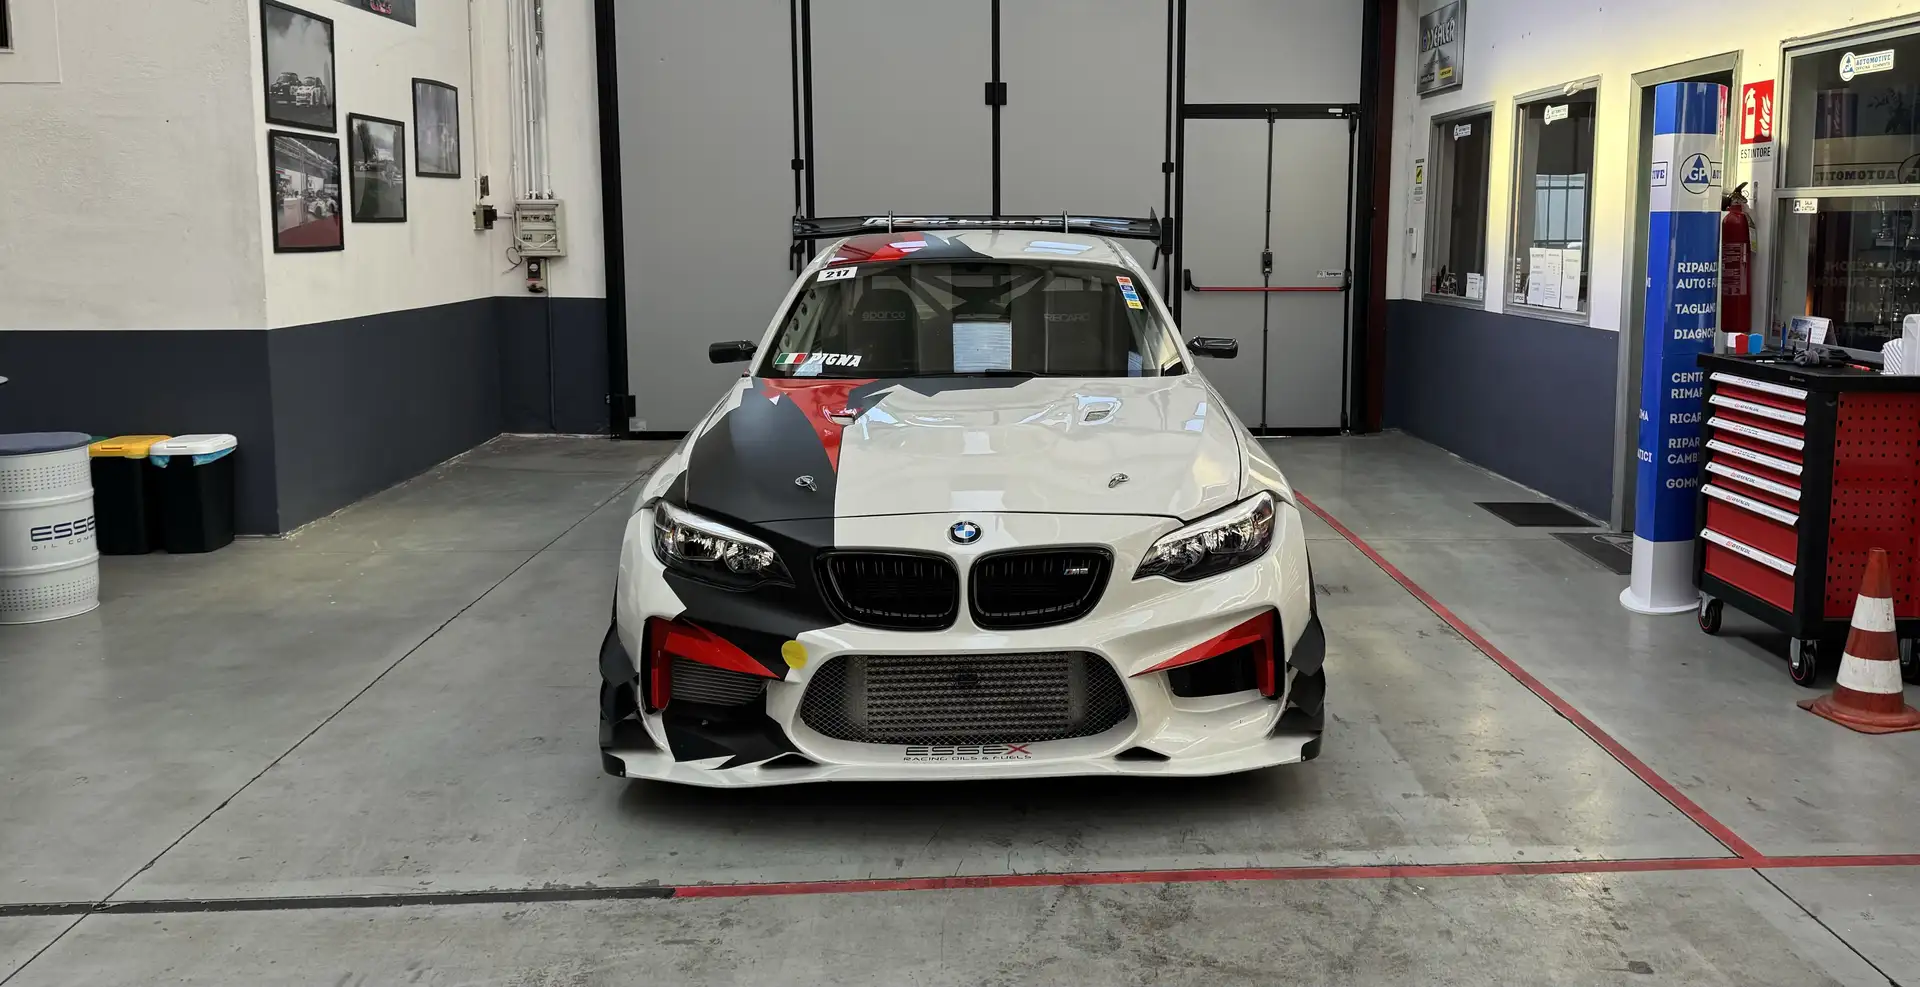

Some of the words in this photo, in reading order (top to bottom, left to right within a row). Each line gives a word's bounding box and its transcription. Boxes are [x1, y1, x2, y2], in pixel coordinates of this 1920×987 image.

[1741, 147, 1771, 159] ESTINTORE
[1688, 168, 1706, 180] GP
[825, 269, 850, 279] 217
[1676, 278, 1706, 289] AUTO
[861, 310, 906, 320] sparco
[811, 352, 862, 368] PIGNA
[906, 743, 1032, 756] ESSEX
